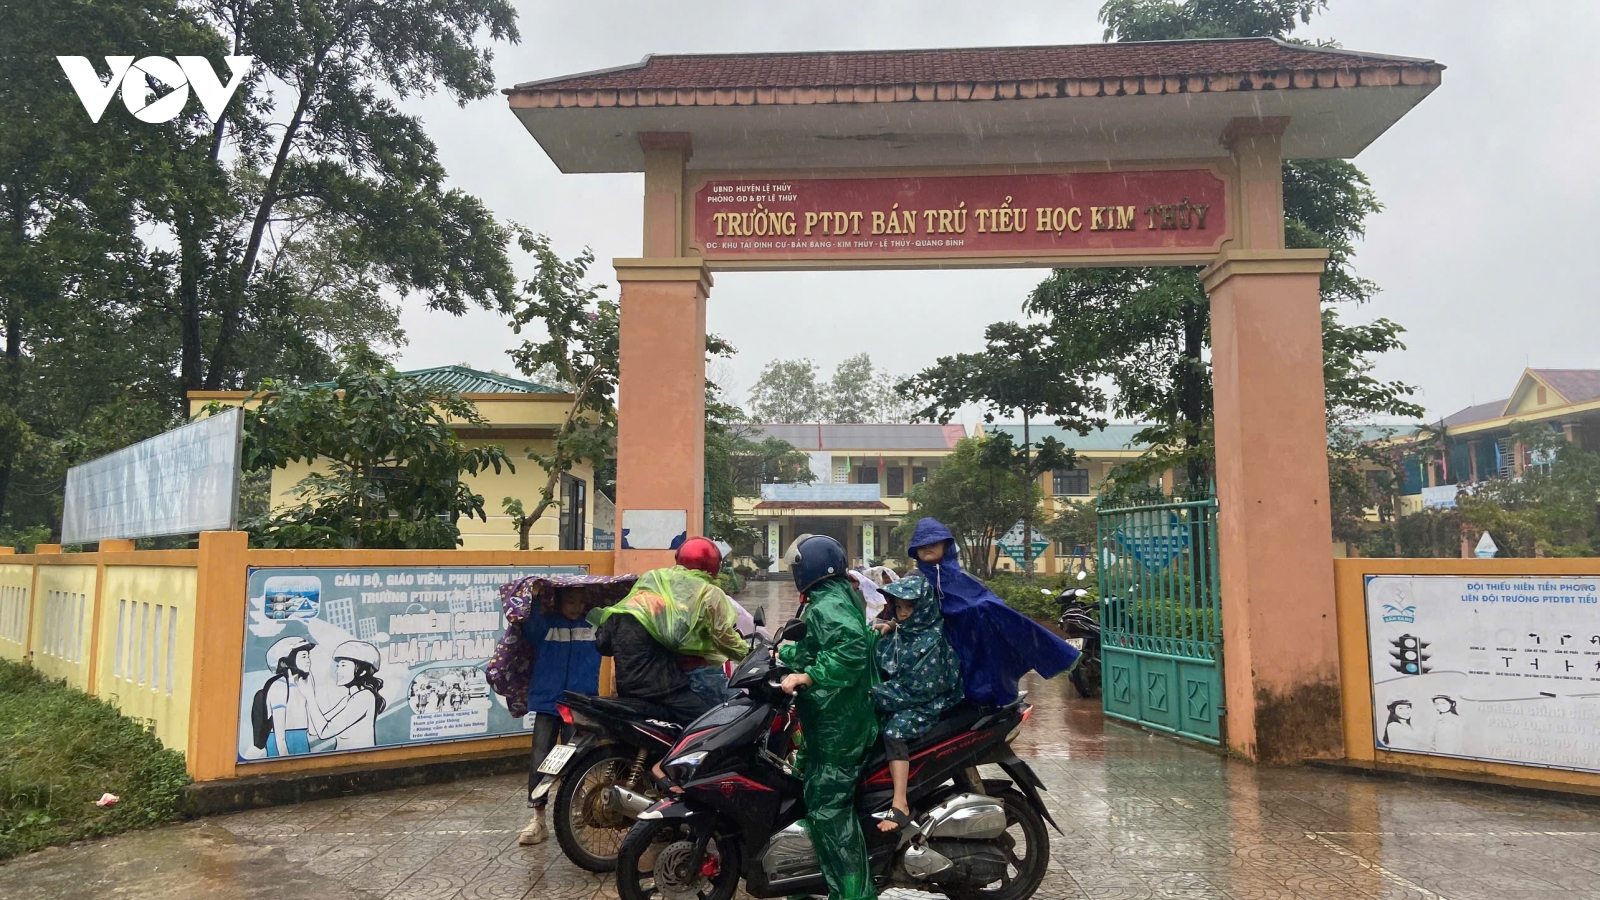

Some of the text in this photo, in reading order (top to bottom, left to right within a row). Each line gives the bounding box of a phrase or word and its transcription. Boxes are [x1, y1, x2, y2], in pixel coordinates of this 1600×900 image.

[736, 184, 760, 193] HUYỆN
[763, 184, 770, 193] LỆ
[772, 182, 791, 192] THỦY
[708, 194, 734, 203] PHÒNG
[768, 194, 776, 203] LỆ
[778, 192, 797, 202] THỦY
[713, 196, 1209, 236] TRƯỜNG PTDT BÁN TRÚ TIỂU HỌC KIM THỦY
[740, 240, 752, 248] TÁI
[754, 242, 772, 250] ĐỊNH
[854, 238, 873, 247] THỦY
[880, 239, 888, 249] LỆ
[946, 238, 964, 246] BÌNH
[335, 573, 360, 586] CÁN
[363, 573, 383, 589] BỘ,
[387, 573, 414, 586] GIÁO
[417, 572, 446, 587] VIÊN,
[449, 573, 471, 589] PHỤ
[474, 573, 509, 584] HUYNH
[1467, 582, 1483, 592] ĐỘI
[1486, 581, 1510, 591] THIẾU
[1514, 582, 1535, 591] NIÊN
[361, 589, 407, 604] TRƯỜNG
[1461, 594, 1479, 602] LIÊN
[1482, 594, 1498, 604] ĐỘI
[1501, 594, 1539, 603] TRƯỜNG
[1578, 593, 1597, 604] TIỂU
